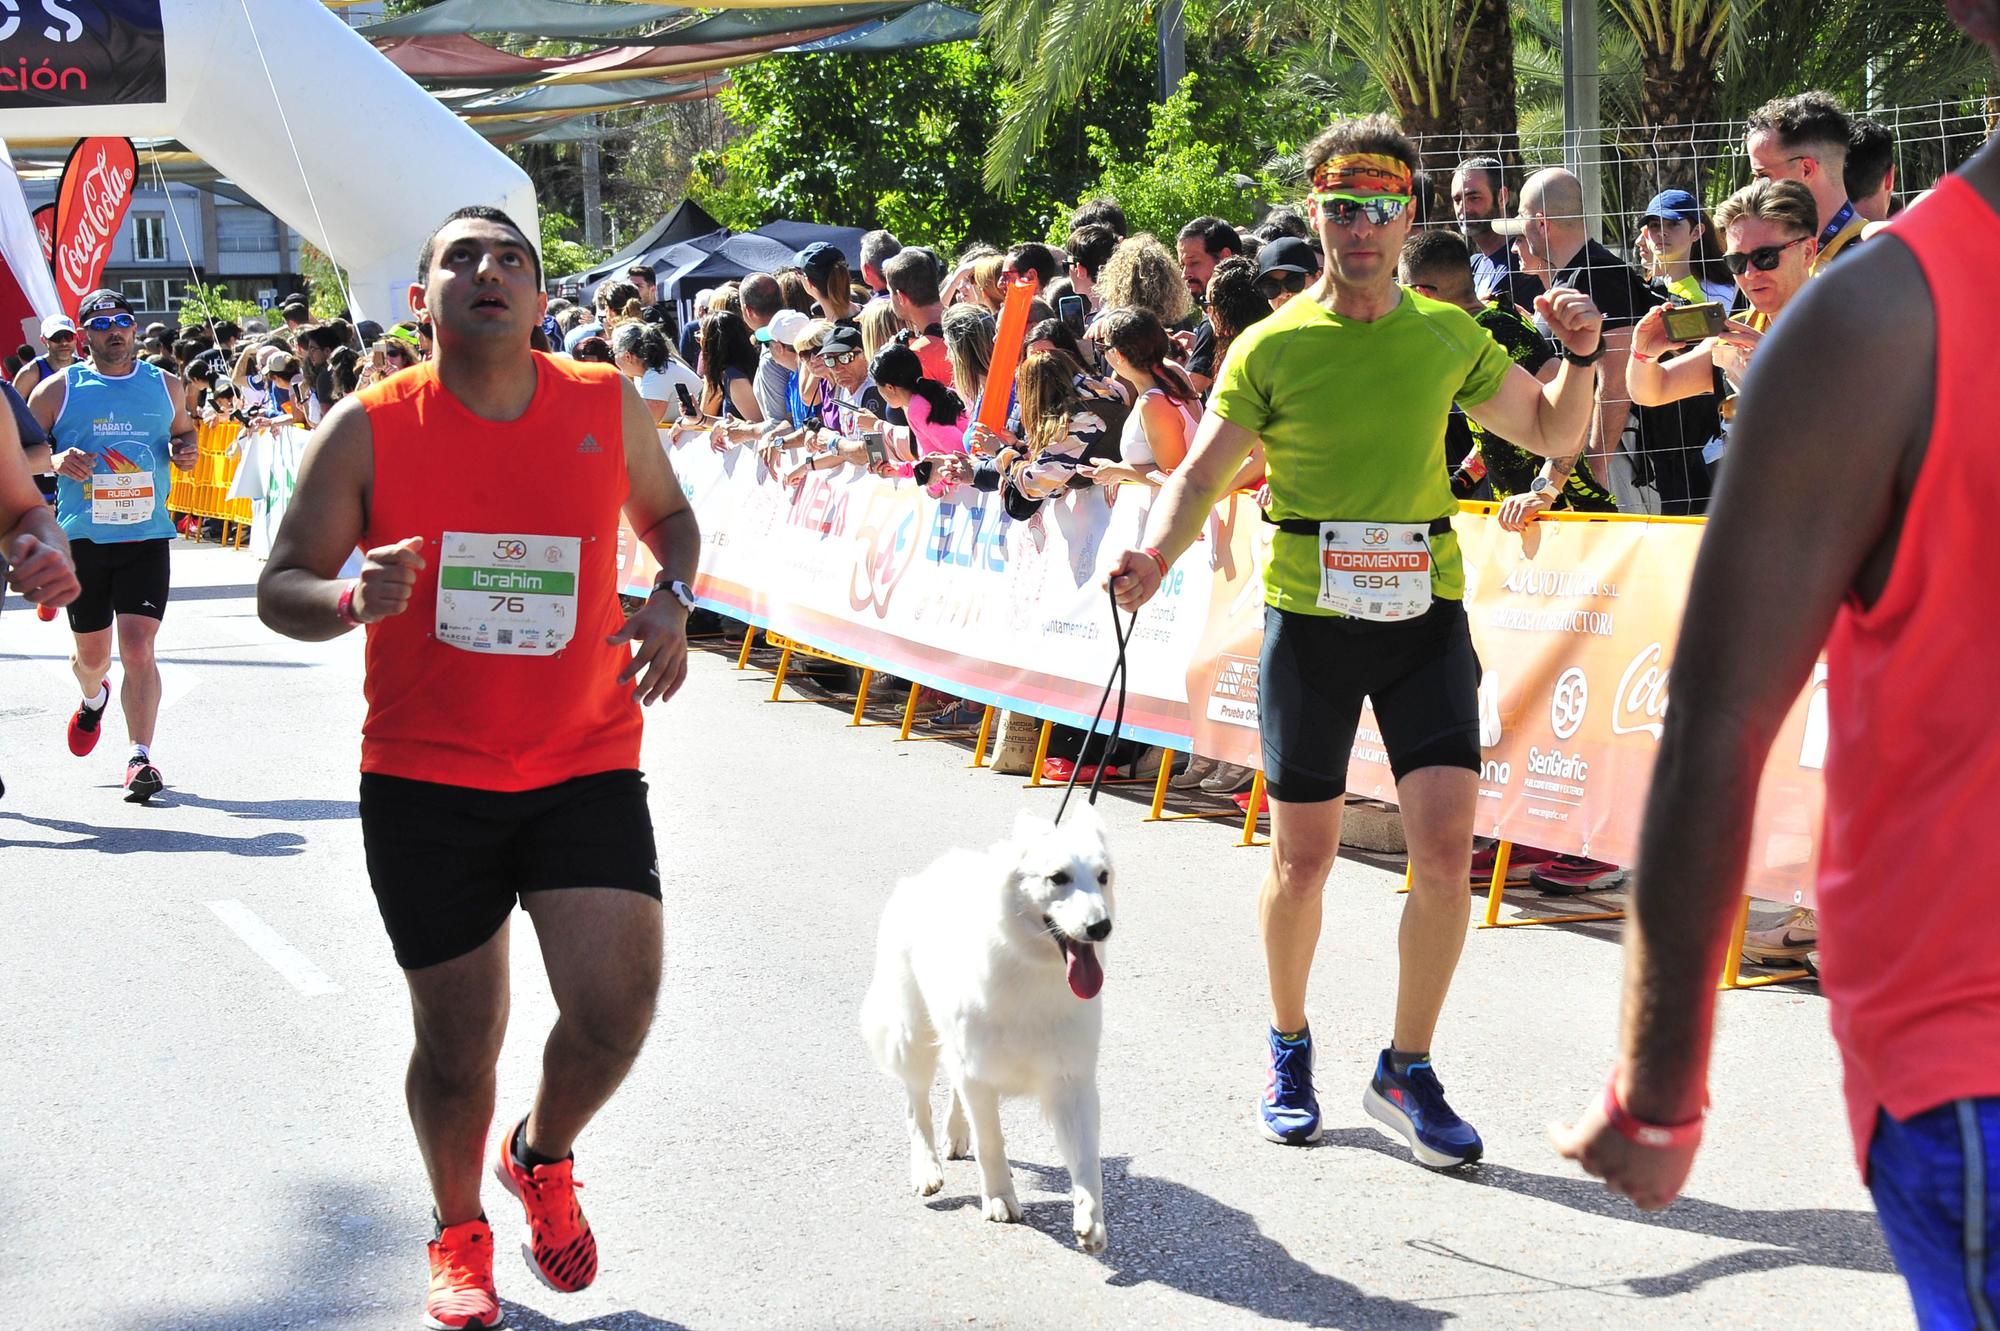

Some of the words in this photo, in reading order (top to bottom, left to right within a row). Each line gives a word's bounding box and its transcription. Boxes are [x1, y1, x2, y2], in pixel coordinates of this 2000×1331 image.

[93, 421, 133, 431] MARATÓ
[115, 499, 134, 508] 1181
[1331, 553, 1420, 569] TORMENTO
[472, 570, 542, 590] Ibrahim
[1353, 575, 1400, 589] 694
[488, 595, 525, 613] 76
[1220, 704, 1245, 719] Prueba
[1527, 746, 1590, 781] SeriGrafic
